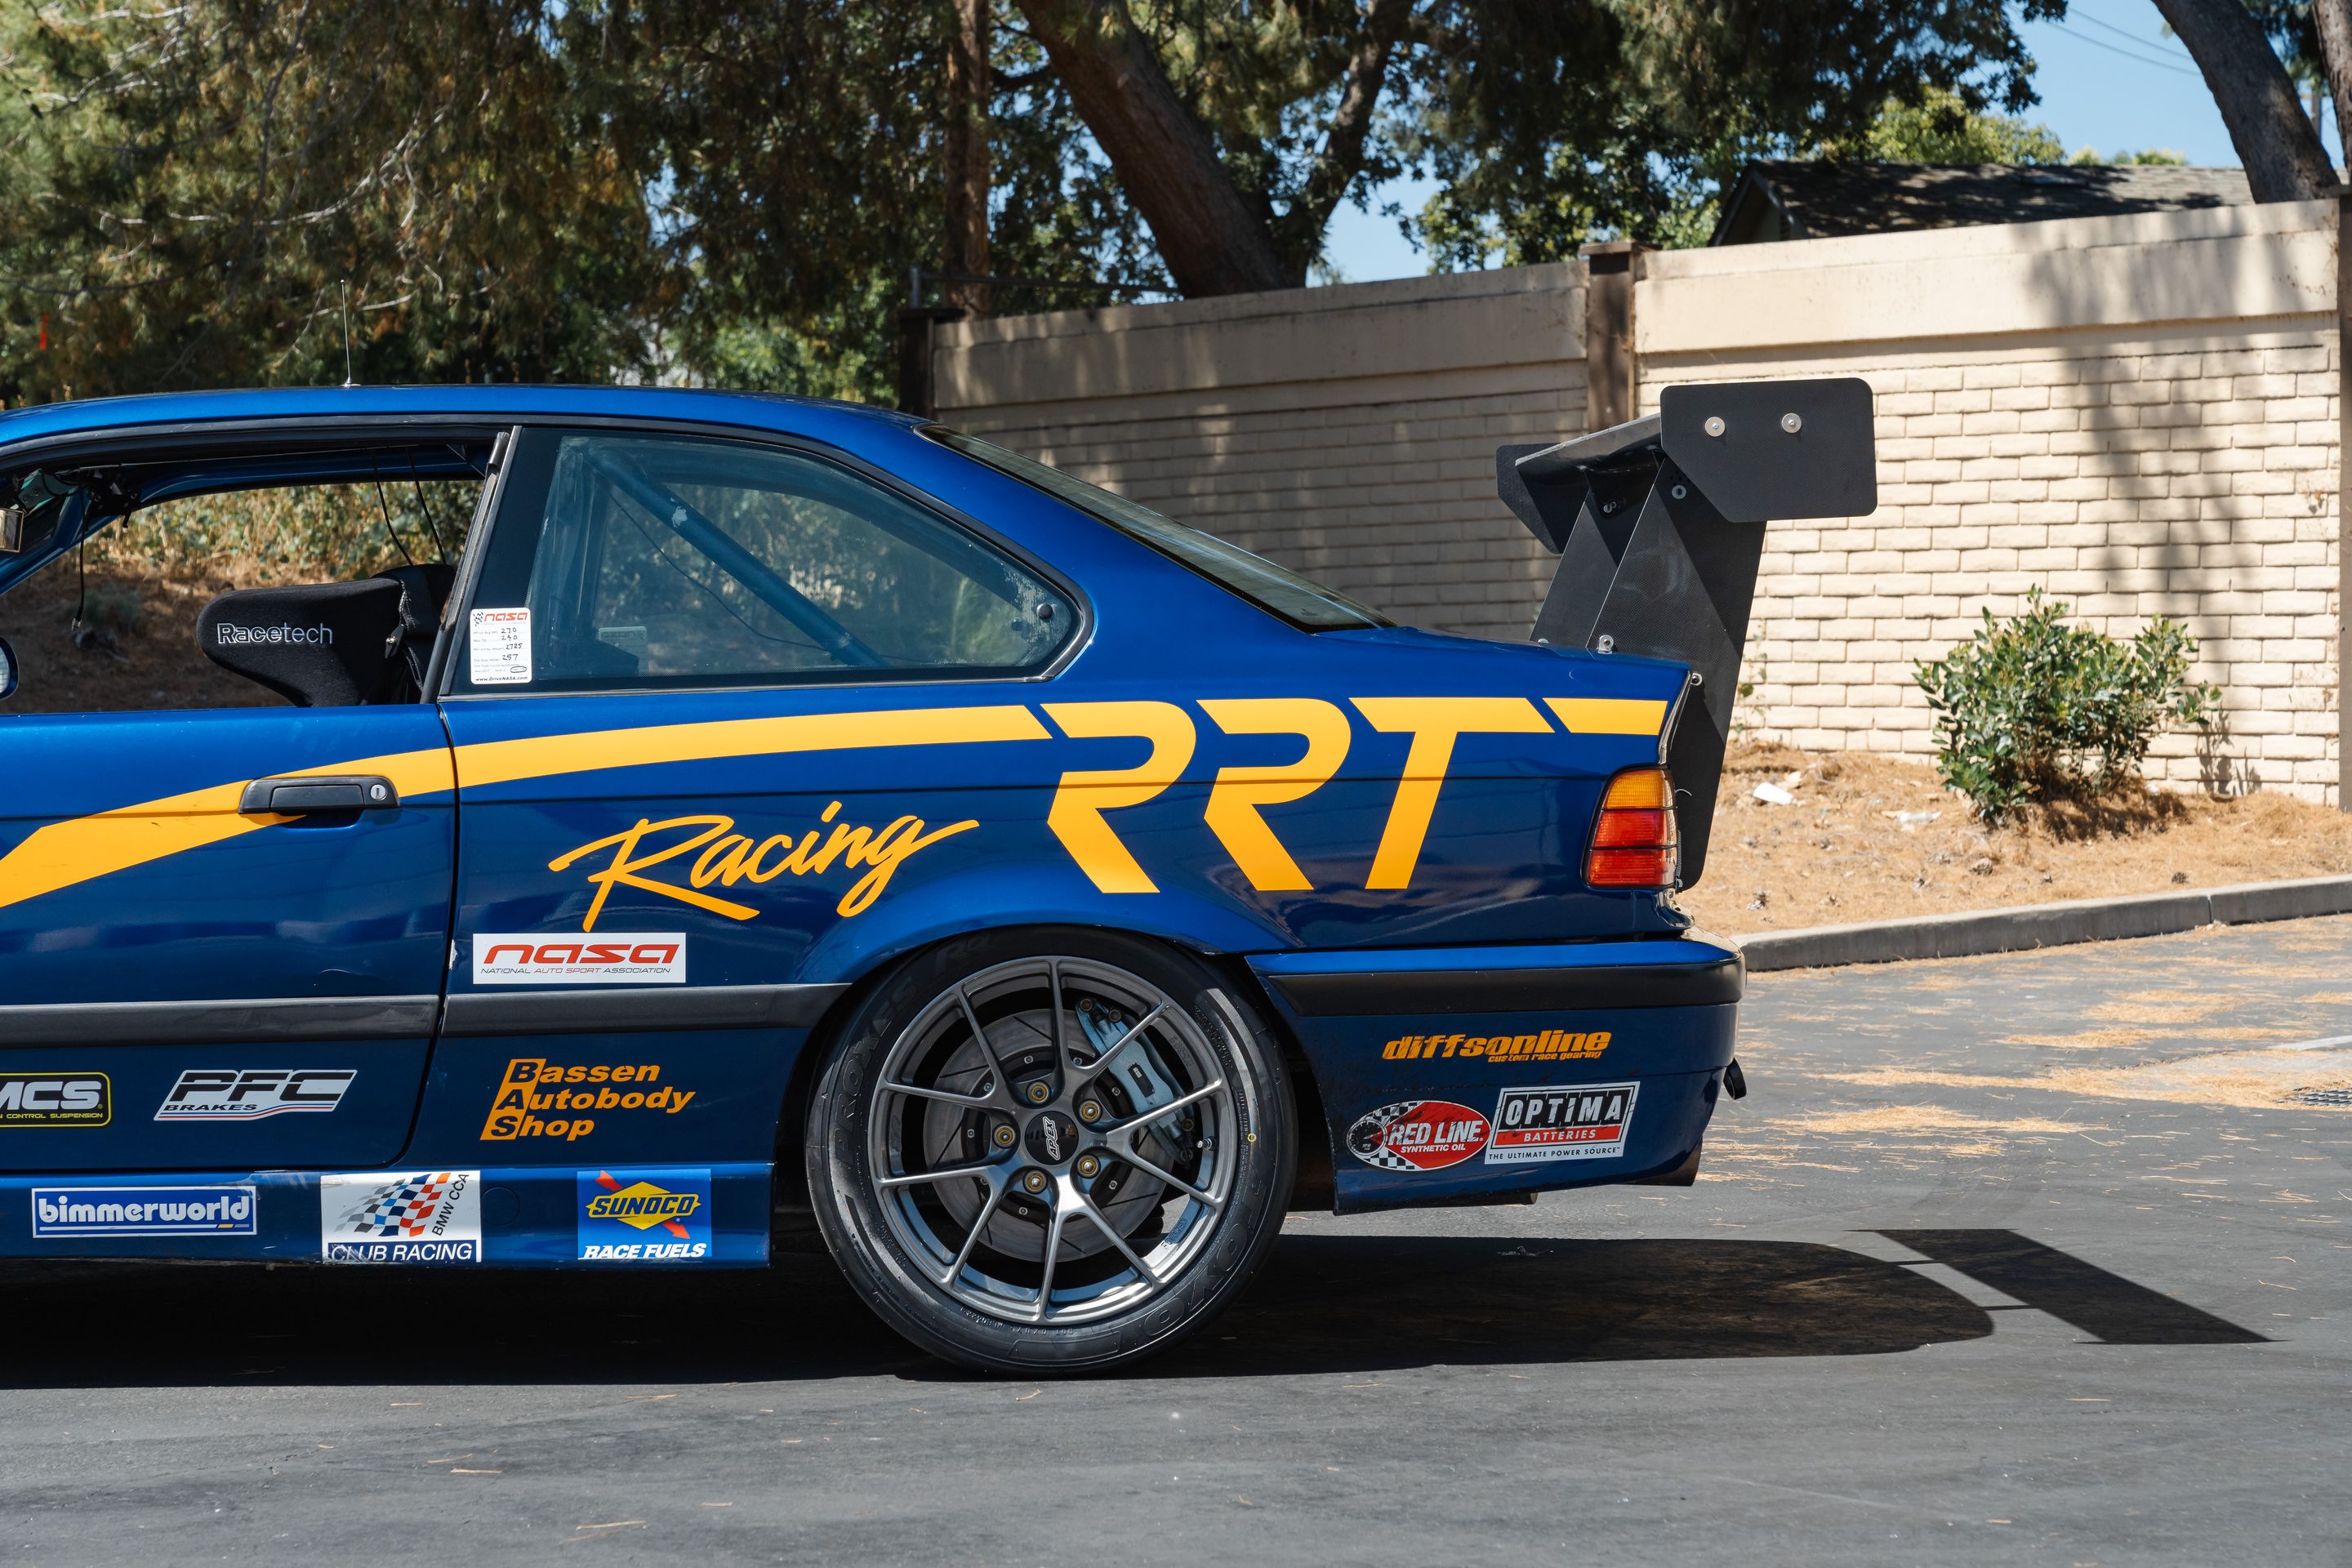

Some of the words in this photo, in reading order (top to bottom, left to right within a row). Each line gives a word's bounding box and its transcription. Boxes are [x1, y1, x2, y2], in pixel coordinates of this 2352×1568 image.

[484, 612, 528, 621] nasa
[217, 622, 332, 644] Racetech
[1040, 697, 1556, 893] RRT
[548, 800, 979, 933] Racing
[483, 944, 679, 964] nasa
[1382, 1030, 1612, 1060] diffsonline
[1488, 1054, 1529, 1062] custom
[1559, 1051, 1601, 1061] gearing
[508, 1062, 661, 1084] Bassen
[168, 1071, 354, 1102] PFC
[495, 1087, 696, 1113] Autobody
[1505, 1095, 1622, 1125] OPTIMA
[491, 1116, 595, 1141] Shop
[1043, 1116, 1060, 1160] APEX
[1388, 1123, 1431, 1145] RED
[1434, 1120, 1483, 1143] LINE
[1524, 1129, 1597, 1142] BATTERIES
[1401, 1144, 1449, 1153] SYNTHETIC
[1508, 1151, 1547, 1159] ULTIMATE
[38, 1196, 249, 1223] bimmerworld
[432, 1202, 455, 1236] BMW
[449, 1174, 469, 1200] CCA
[592, 1196, 695, 1215] SUNOCO
[331, 1245, 387, 1262] CLUB
[392, 1243, 472, 1262] RACING
[584, 1245, 642, 1258] RACE
[641, 1243, 706, 1258] FUELS
